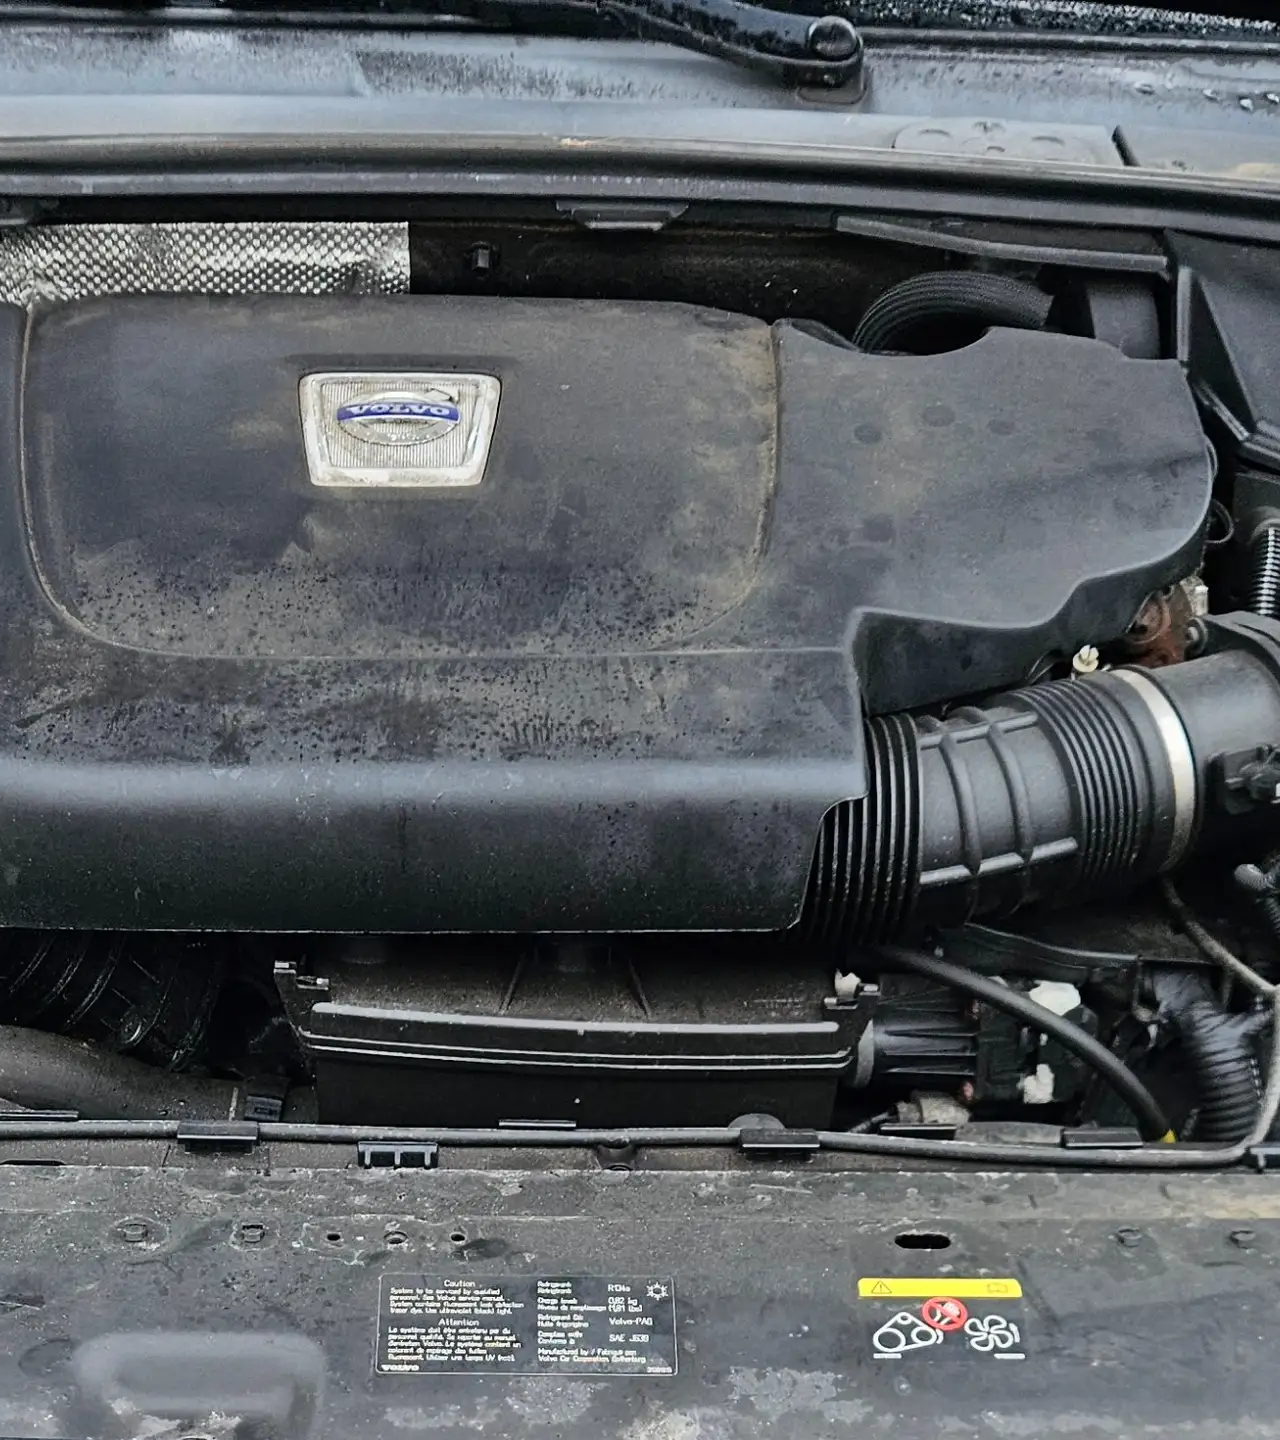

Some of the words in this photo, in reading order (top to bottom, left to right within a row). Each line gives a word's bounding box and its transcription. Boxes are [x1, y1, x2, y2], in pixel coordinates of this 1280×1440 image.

[346, 403, 451, 416] VOLVO
[444, 1280, 476, 1288] Caution
[438, 1318, 480, 1326] Attention
[609, 1333, 626, 1342] SAE
